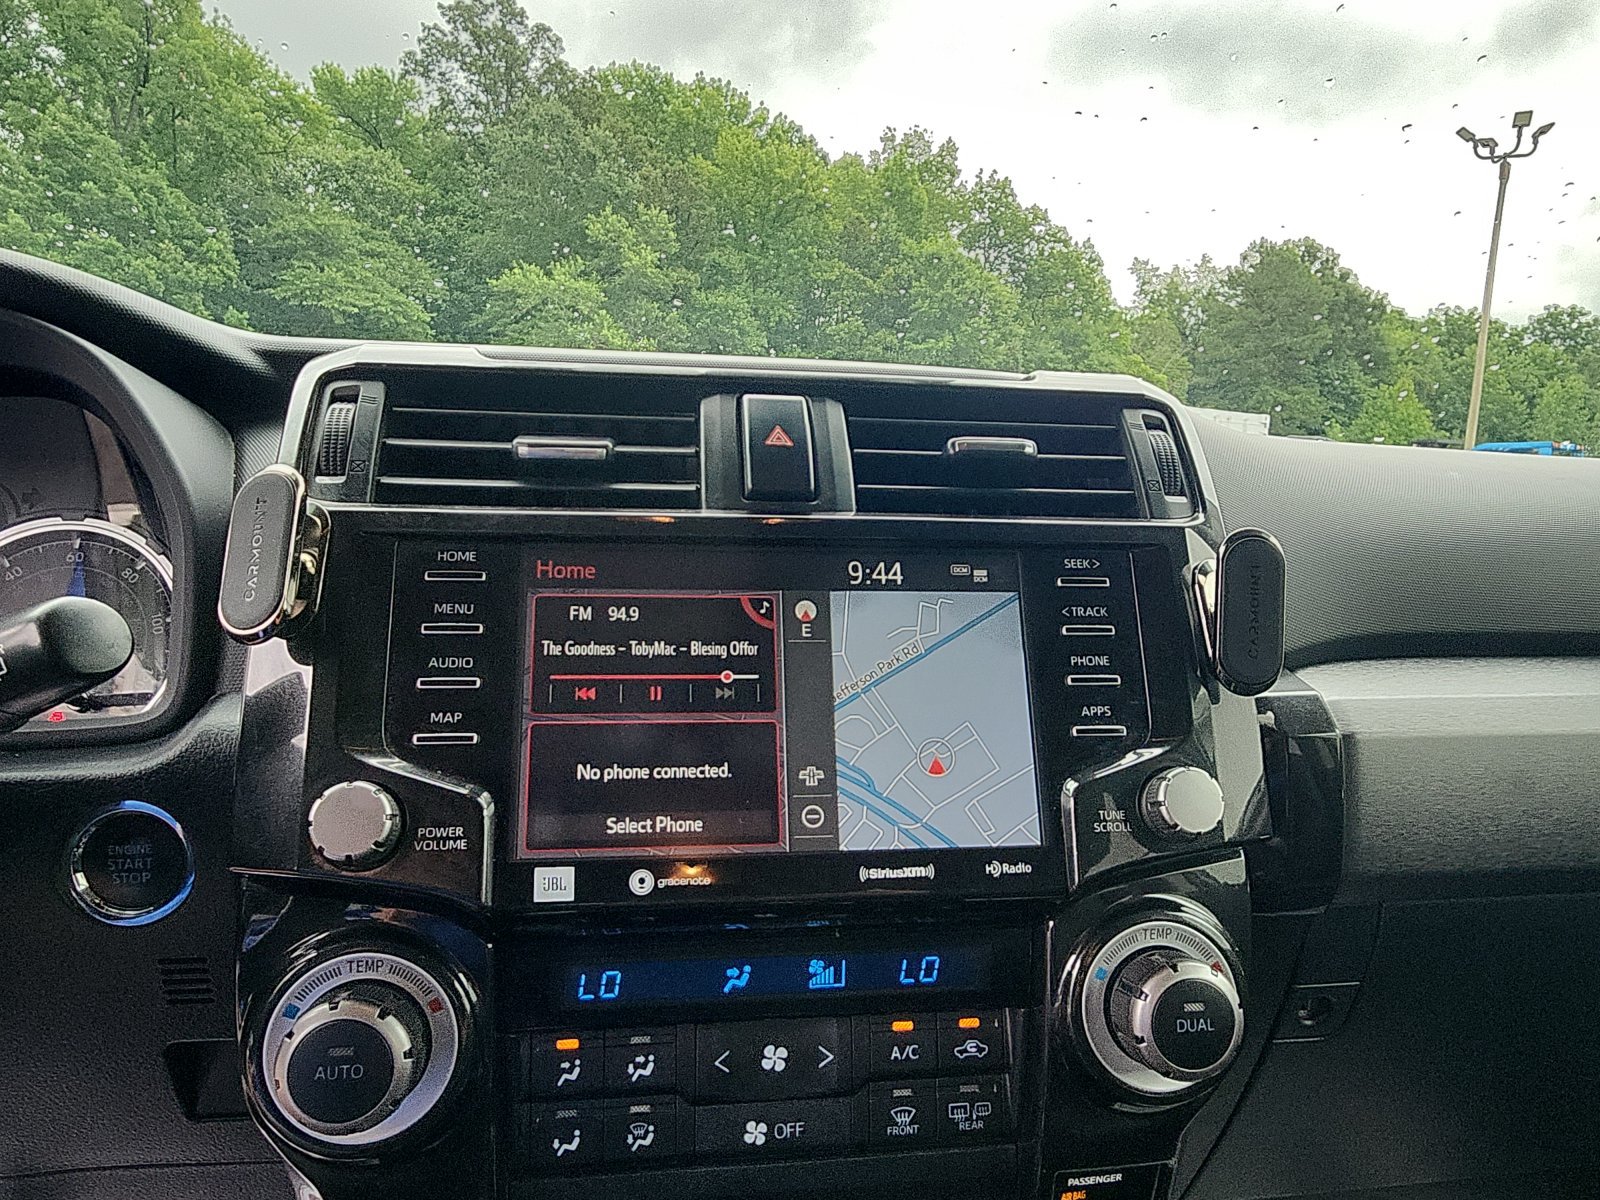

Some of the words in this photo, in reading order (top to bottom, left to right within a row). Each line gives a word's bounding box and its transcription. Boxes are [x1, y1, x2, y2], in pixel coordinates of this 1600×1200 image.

[244, 497, 267, 602] CARMOUNT
[437, 551, 477, 562] HOME
[66, 551, 84, 563] 60
[5, 566, 23, 581] 40
[121, 567, 140, 584] 80
[536, 560, 596, 579] Home
[848, 561, 904, 585] 9:44
[434, 603, 474, 615] MENU
[569, 606, 592, 621] FM
[608, 606, 640, 622] 94.9
[151, 612, 164, 635] 100
[802, 623, 813, 638] E
[541, 640, 561, 656] The
[564, 640, 616, 656] Goodness
[629, 640, 677, 659] TobyMac
[690, 640, 728, 659] Blesing
[729, 640, 759, 656] Offor
[428, 657, 474, 669] AUDIO
[877, 655, 904, 674] Park
[901, 642, 919, 660] Rd
[1070, 655, 1110, 667] PHONE
[430, 712, 463, 724] MAP
[1081, 705, 1111, 717] APPS
[576, 763, 601, 781] No
[603, 763, 650, 783] phone
[652, 762, 733, 779] connected.
[1098, 810, 1126, 821] TUNE
[606, 816, 652, 835] Select
[655, 815, 703, 833] Phone
[1093, 821, 1133, 833] SCROLL
[417, 826, 464, 839] POWER
[108, 844, 153, 855] ENGINE
[414, 839, 468, 851] VOLUME
[107, 858, 153, 871] START
[1002, 861, 1032, 874] Radio
[112, 872, 152, 884] STOP
[542, 876, 567, 892] JBL
[657, 877, 711, 888] gracenote
[1142, 927, 1173, 941] TEMP
[347, 959, 385, 974] TEMP
[1176, 1018, 1215, 1033] DUAL
[891, 1044, 920, 1060] A/C
[314, 1064, 364, 1081] AUTO
[774, 1122, 805, 1140] OFF
[887, 1124, 920, 1136] FRONT
[959, 1120, 984, 1131] REAR
[1067, 1173, 1123, 1187] PASSENGER
